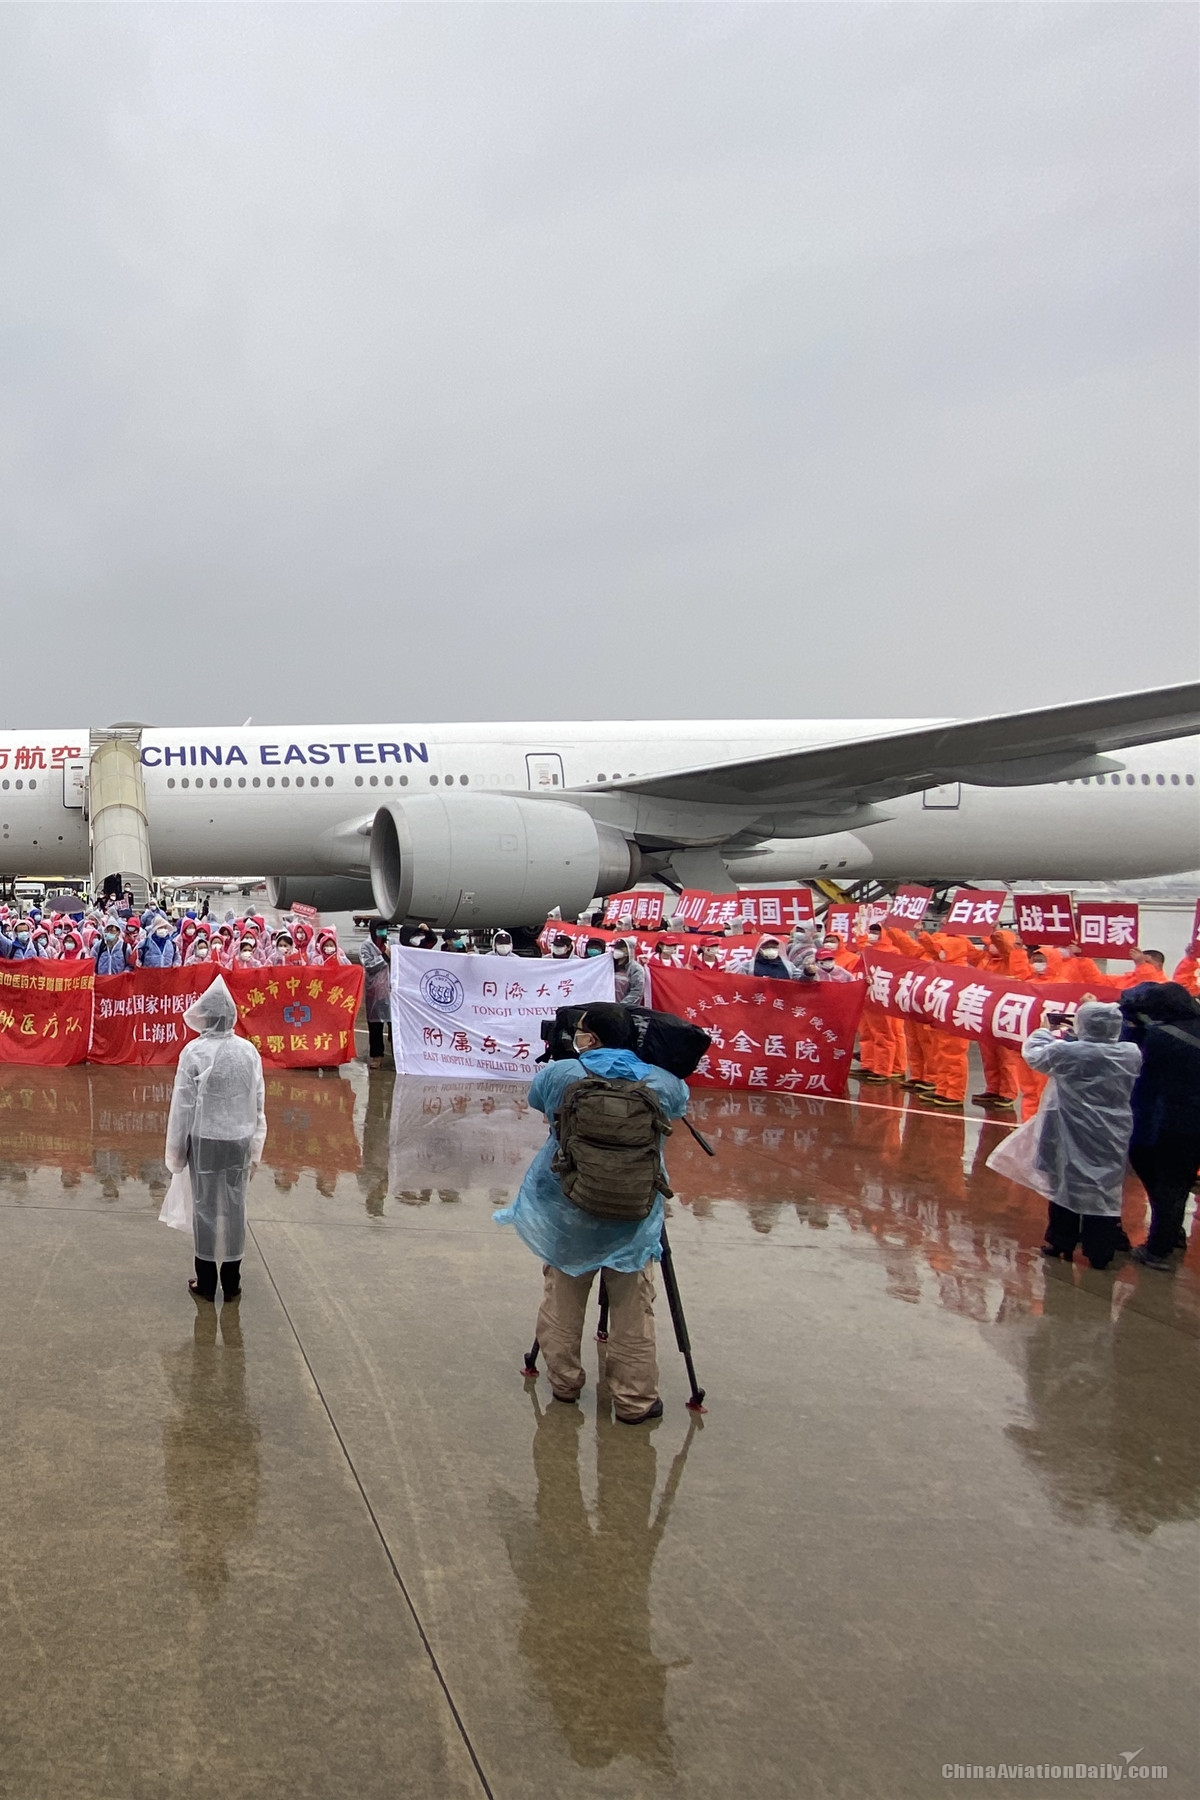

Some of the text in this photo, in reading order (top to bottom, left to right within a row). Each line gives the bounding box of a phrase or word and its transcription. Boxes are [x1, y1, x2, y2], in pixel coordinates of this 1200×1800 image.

[141, 743, 429, 767] CHINA EASTERN
[606, 900, 634, 920] 春回
[674, 896, 706, 921] 山川
[739, 898, 810, 925] 真国士
[891, 895, 927, 919] 欢迎
[948, 899, 1000, 924] 白衣
[1019, 905, 1070, 932] 战士
[1080, 915, 1135, 944] 回家
[472, 1005, 512, 1016] TONGJI
[441, 1053, 474, 1067] HOSPITAL
